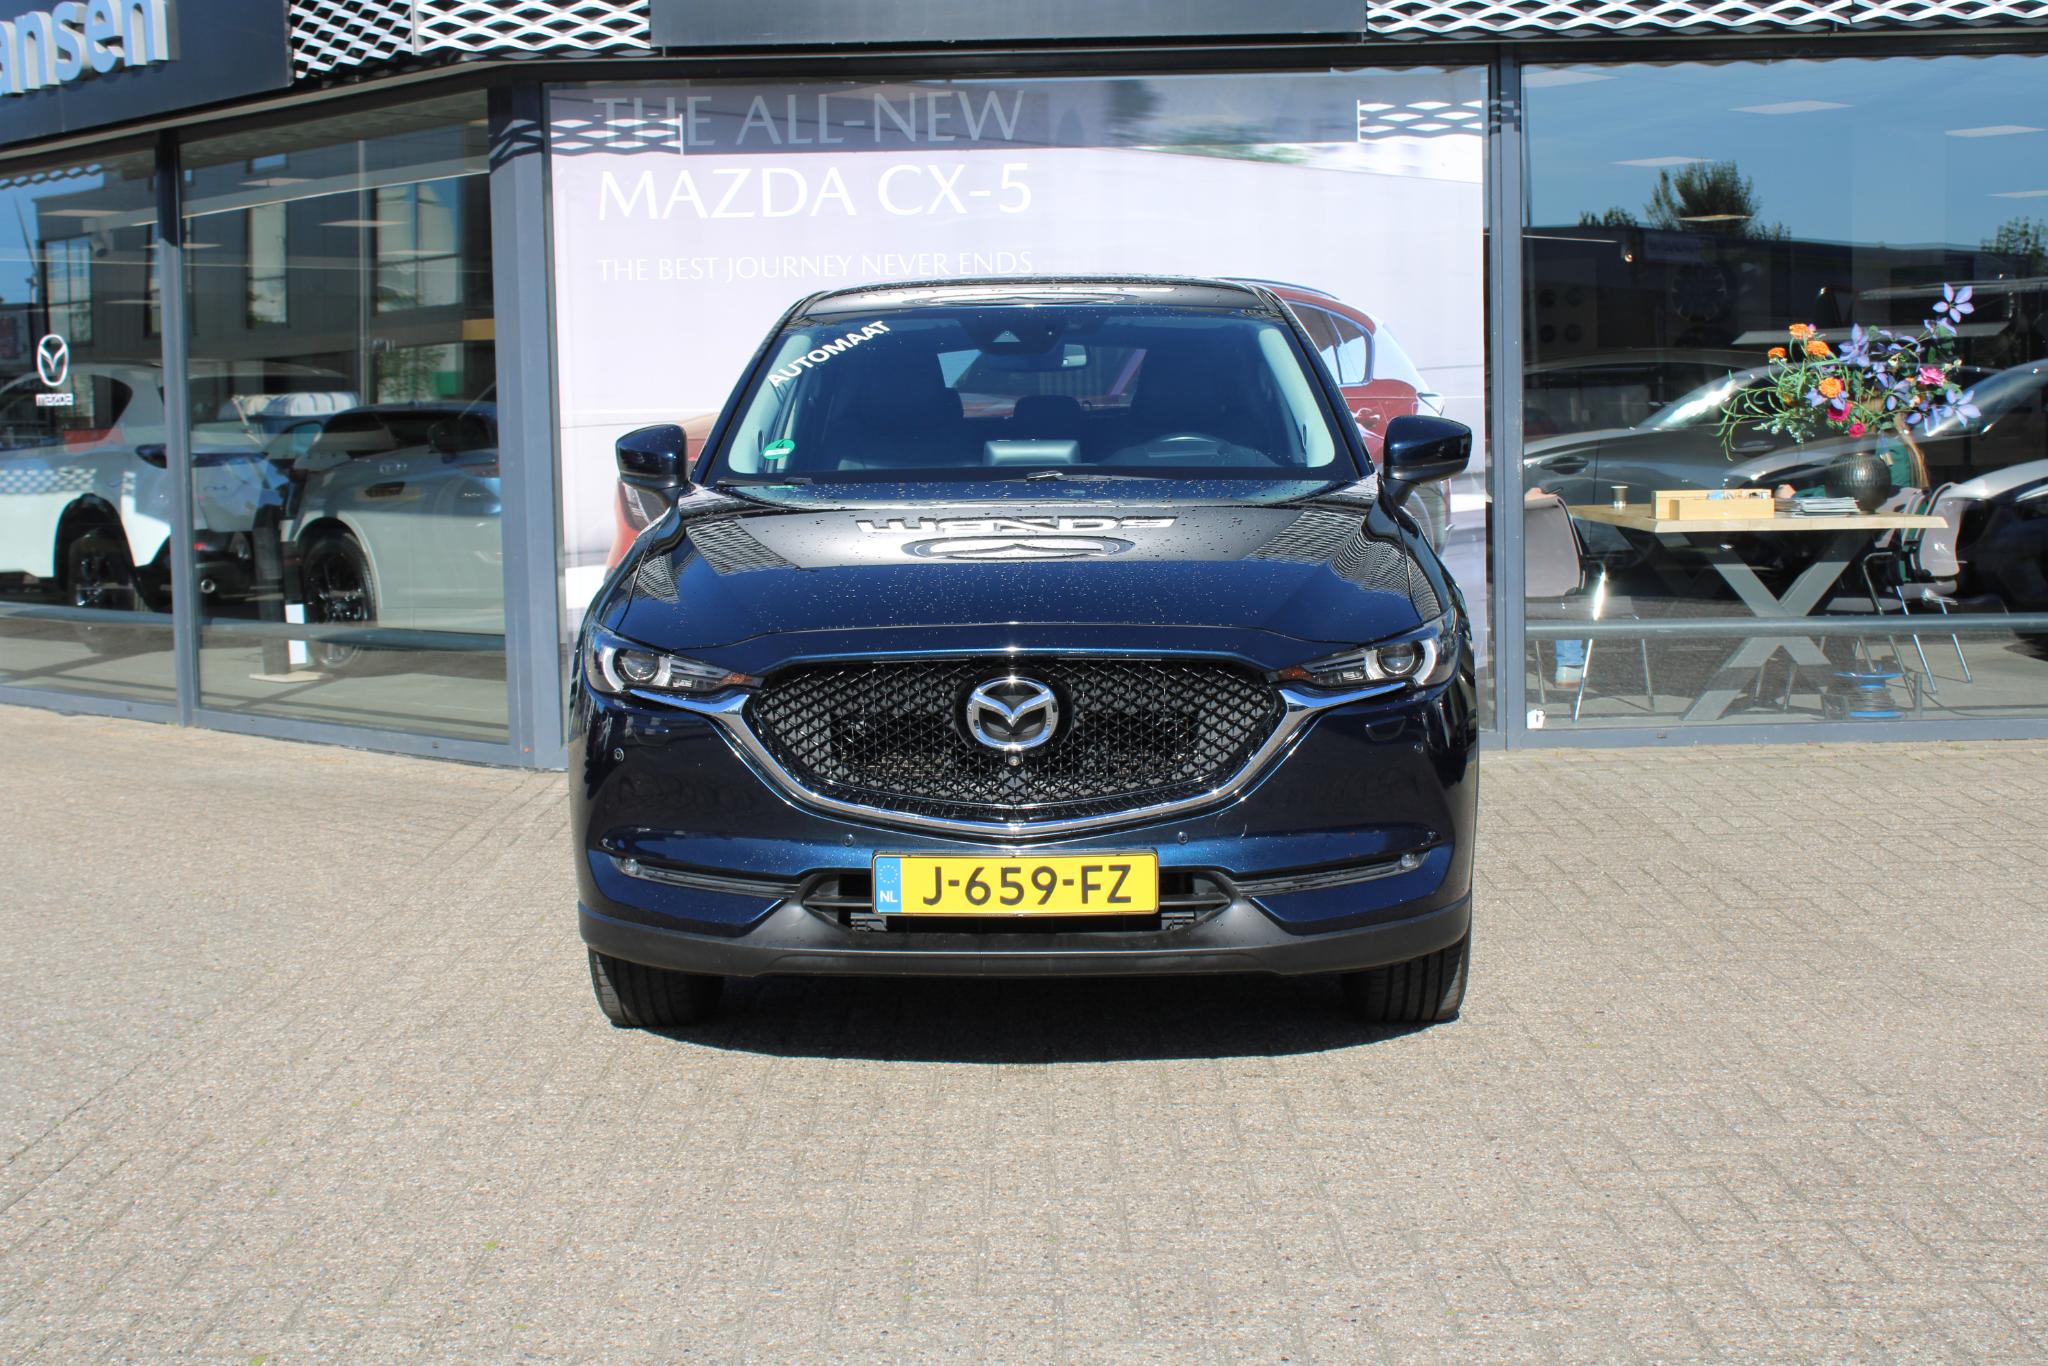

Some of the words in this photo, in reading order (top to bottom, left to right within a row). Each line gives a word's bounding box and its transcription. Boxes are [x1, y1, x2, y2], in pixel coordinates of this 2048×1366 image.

[593, 95, 716, 147] THE
[735, 90, 1024, 146] ALL-NEW
[598, 166, 857, 221] MAZDA
[878, 162, 1033, 217] CX-5
[597, 257, 649, 282] THE
[658, 256, 720, 281] BEST
[726, 254, 852, 283] JOURNEY
[862, 252, 950, 278] NEVER
[959, 250, 1033, 275] ENDS
[767, 320, 891, 388] AUTOMAAT
[879, 891, 899, 904] NL
[922, 864, 1132, 906] J-659-FZ
